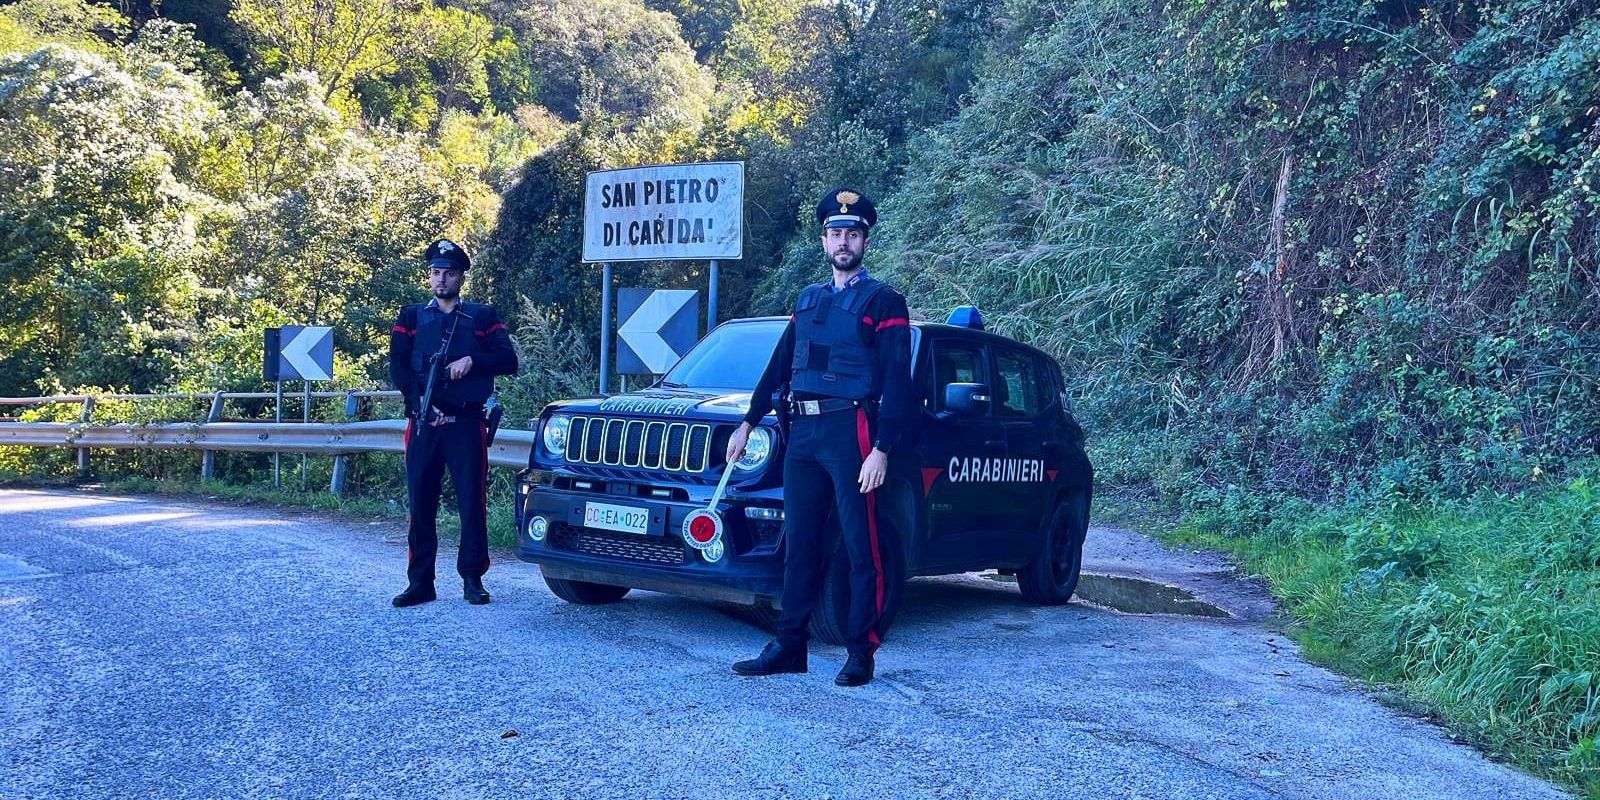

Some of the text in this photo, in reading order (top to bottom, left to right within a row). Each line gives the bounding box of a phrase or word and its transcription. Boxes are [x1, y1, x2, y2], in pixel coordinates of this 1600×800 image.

[601, 177, 719, 208] SAN PIETRO
[603, 222, 621, 247] DI
[600, 400, 691, 416] CARABINIERI
[948, 456, 1044, 483] CARABINIERI
[586, 507, 646, 529] CC EA 022
